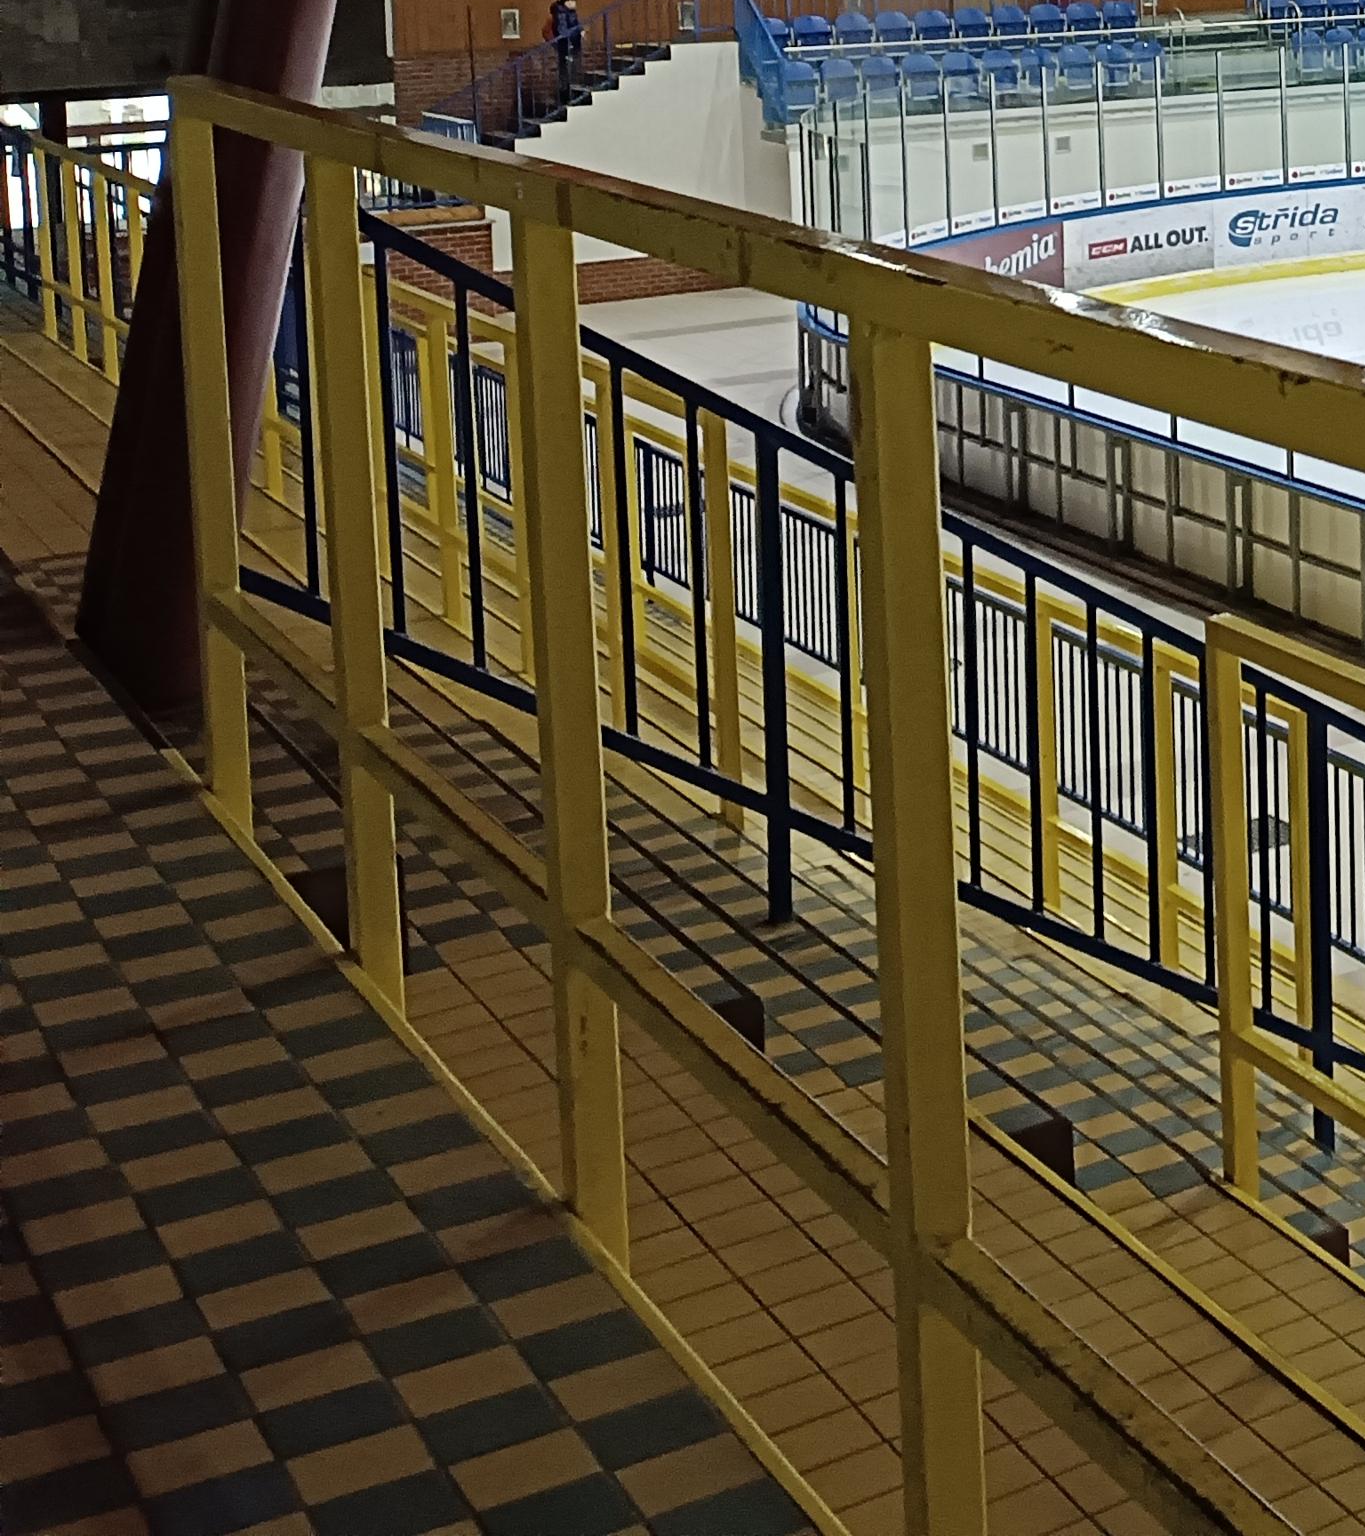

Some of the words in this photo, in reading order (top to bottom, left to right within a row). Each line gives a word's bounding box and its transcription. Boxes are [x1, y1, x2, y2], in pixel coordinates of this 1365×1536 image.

[1129, 232, 1163, 253] ALL
[1166, 225, 1209, 247] OUT.
[1253, 227, 1336, 246] sport
[985, 232, 1056, 277] hemia
[1090, 242, 1126, 256] CCM
